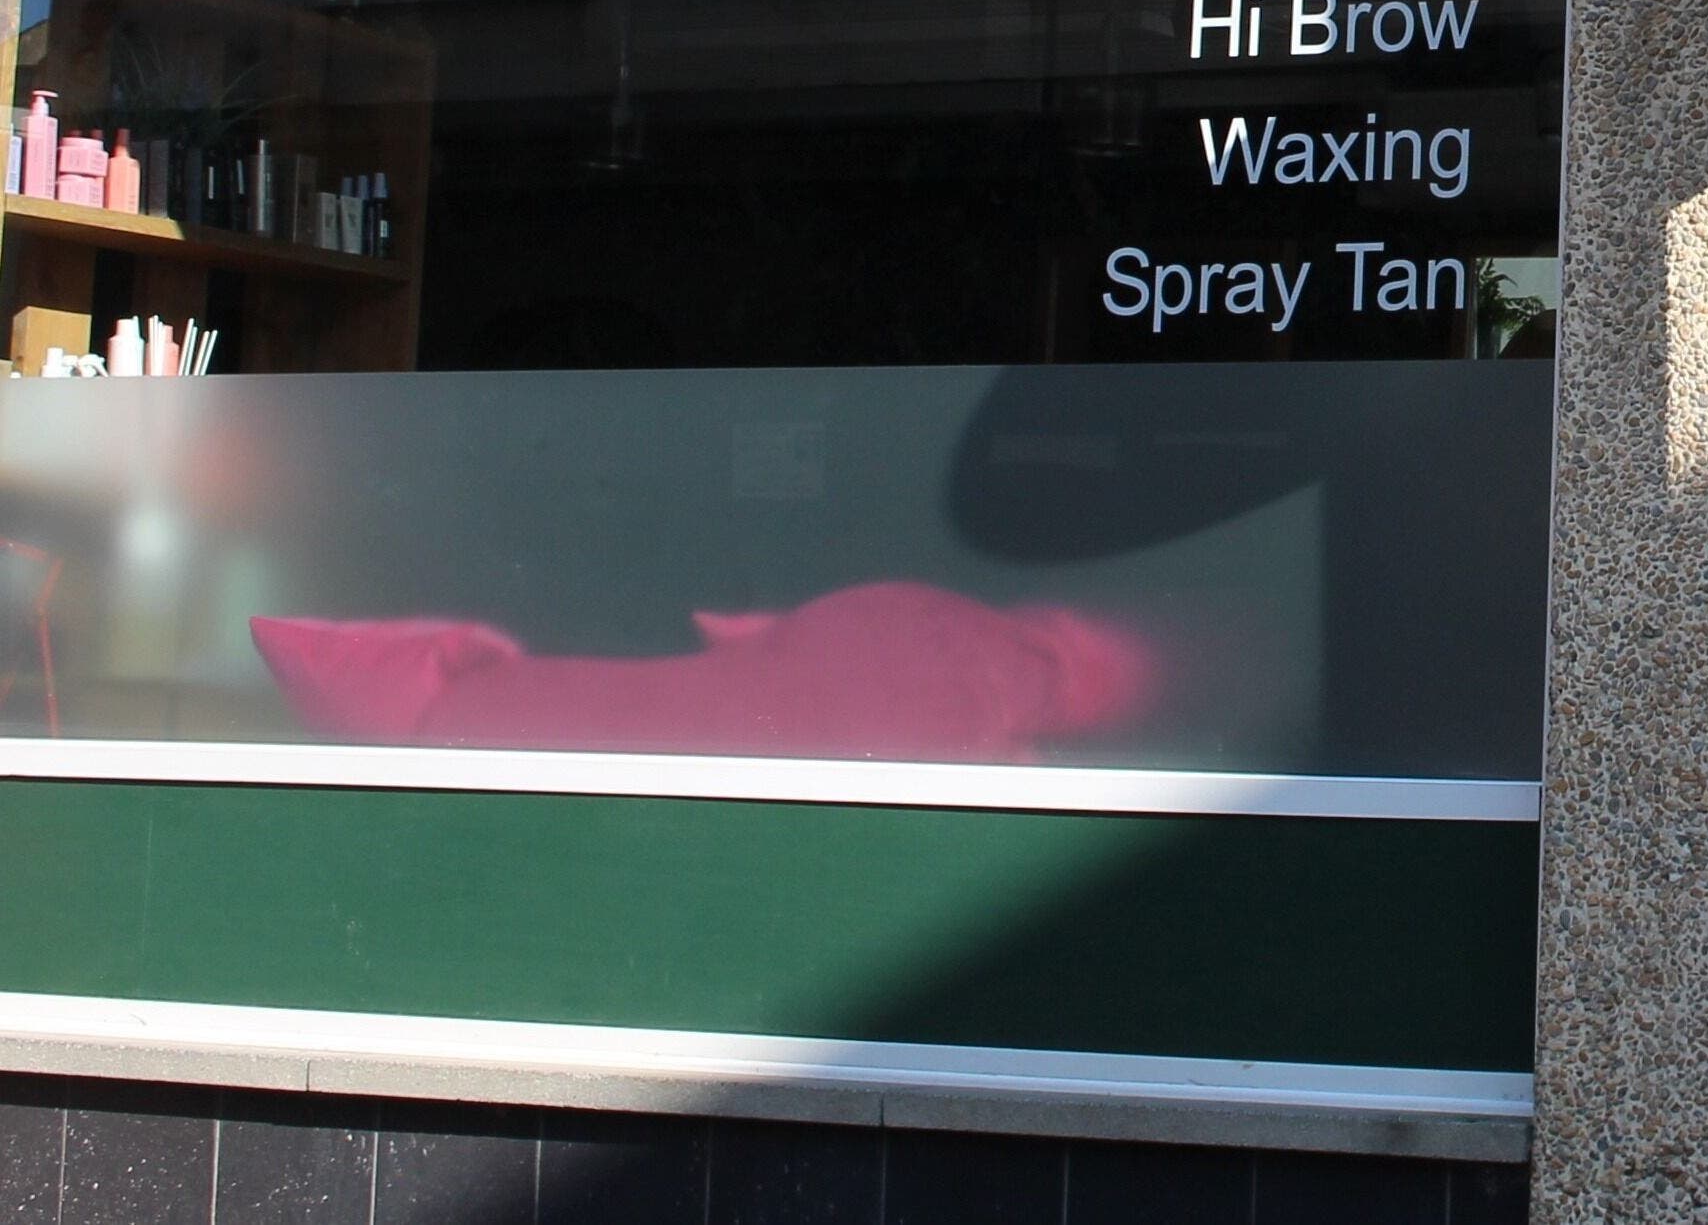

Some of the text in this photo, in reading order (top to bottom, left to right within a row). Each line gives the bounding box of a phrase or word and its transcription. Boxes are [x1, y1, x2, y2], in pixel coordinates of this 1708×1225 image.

[1199, 112, 1470, 199] Waxing
[1102, 241, 1466, 333] Spray Tan
